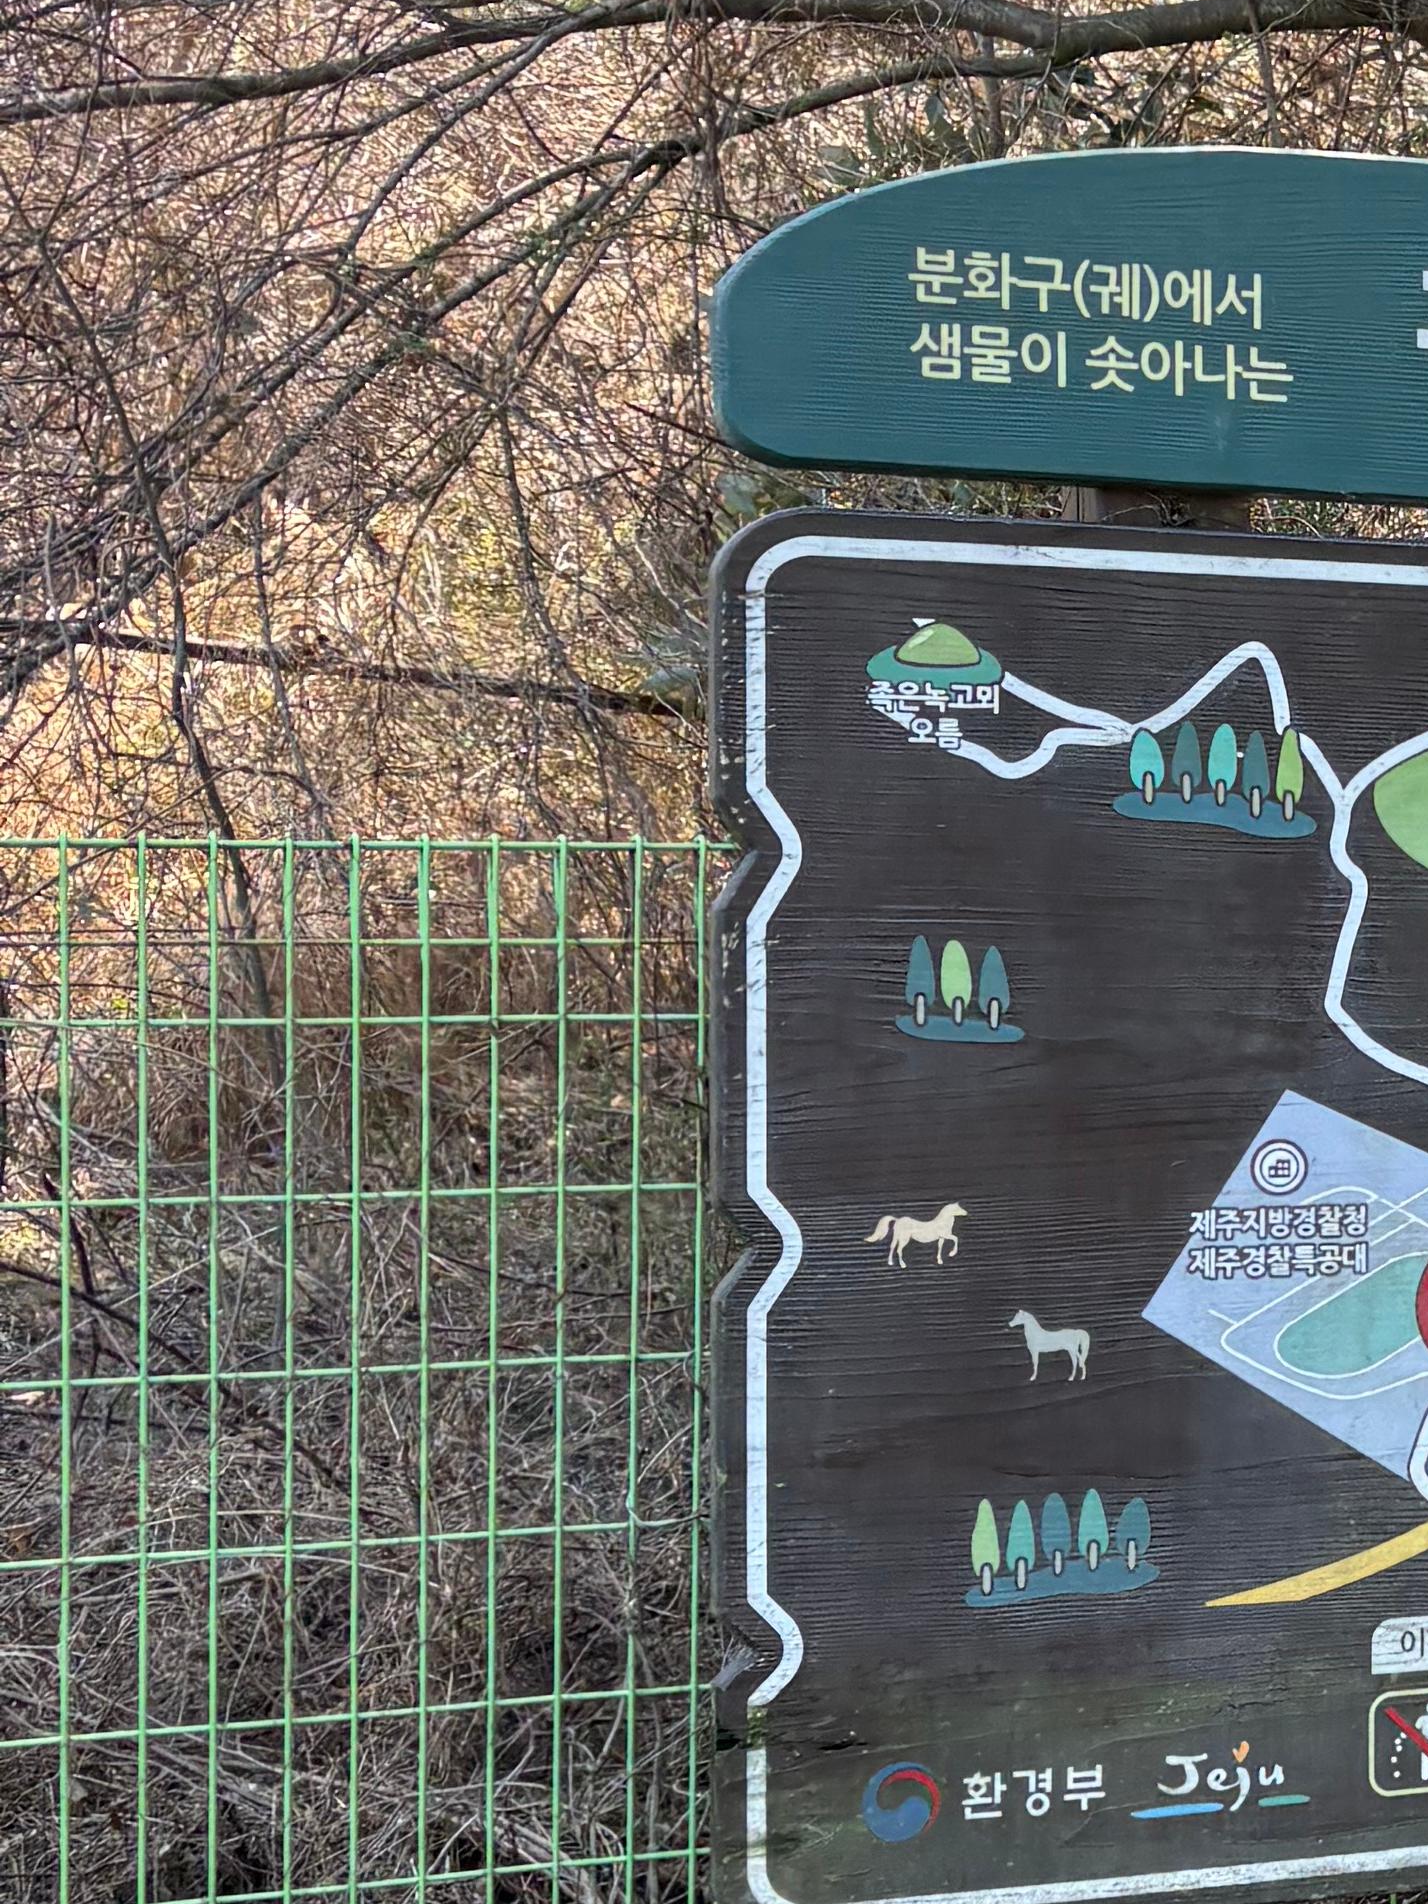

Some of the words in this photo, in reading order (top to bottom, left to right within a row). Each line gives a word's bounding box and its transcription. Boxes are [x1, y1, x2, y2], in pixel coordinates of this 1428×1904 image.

[908, 247, 1262, 330] 분화구(궤)에서
[910, 323, 1067, 388] 샘물이
[1085, 336, 1294, 403] 솟아나는
[868, 681, 1000, 714] 족은녹고뫼
[908, 718, 963, 748] 오름
[1189, 1205, 1366, 1240] 제주지방경찰청
[1189, 1243, 1367, 1278] 제주경찰특공대
[961, 1764, 1107, 1820] 환경부
[1156, 1741, 1287, 1812] Jeju
